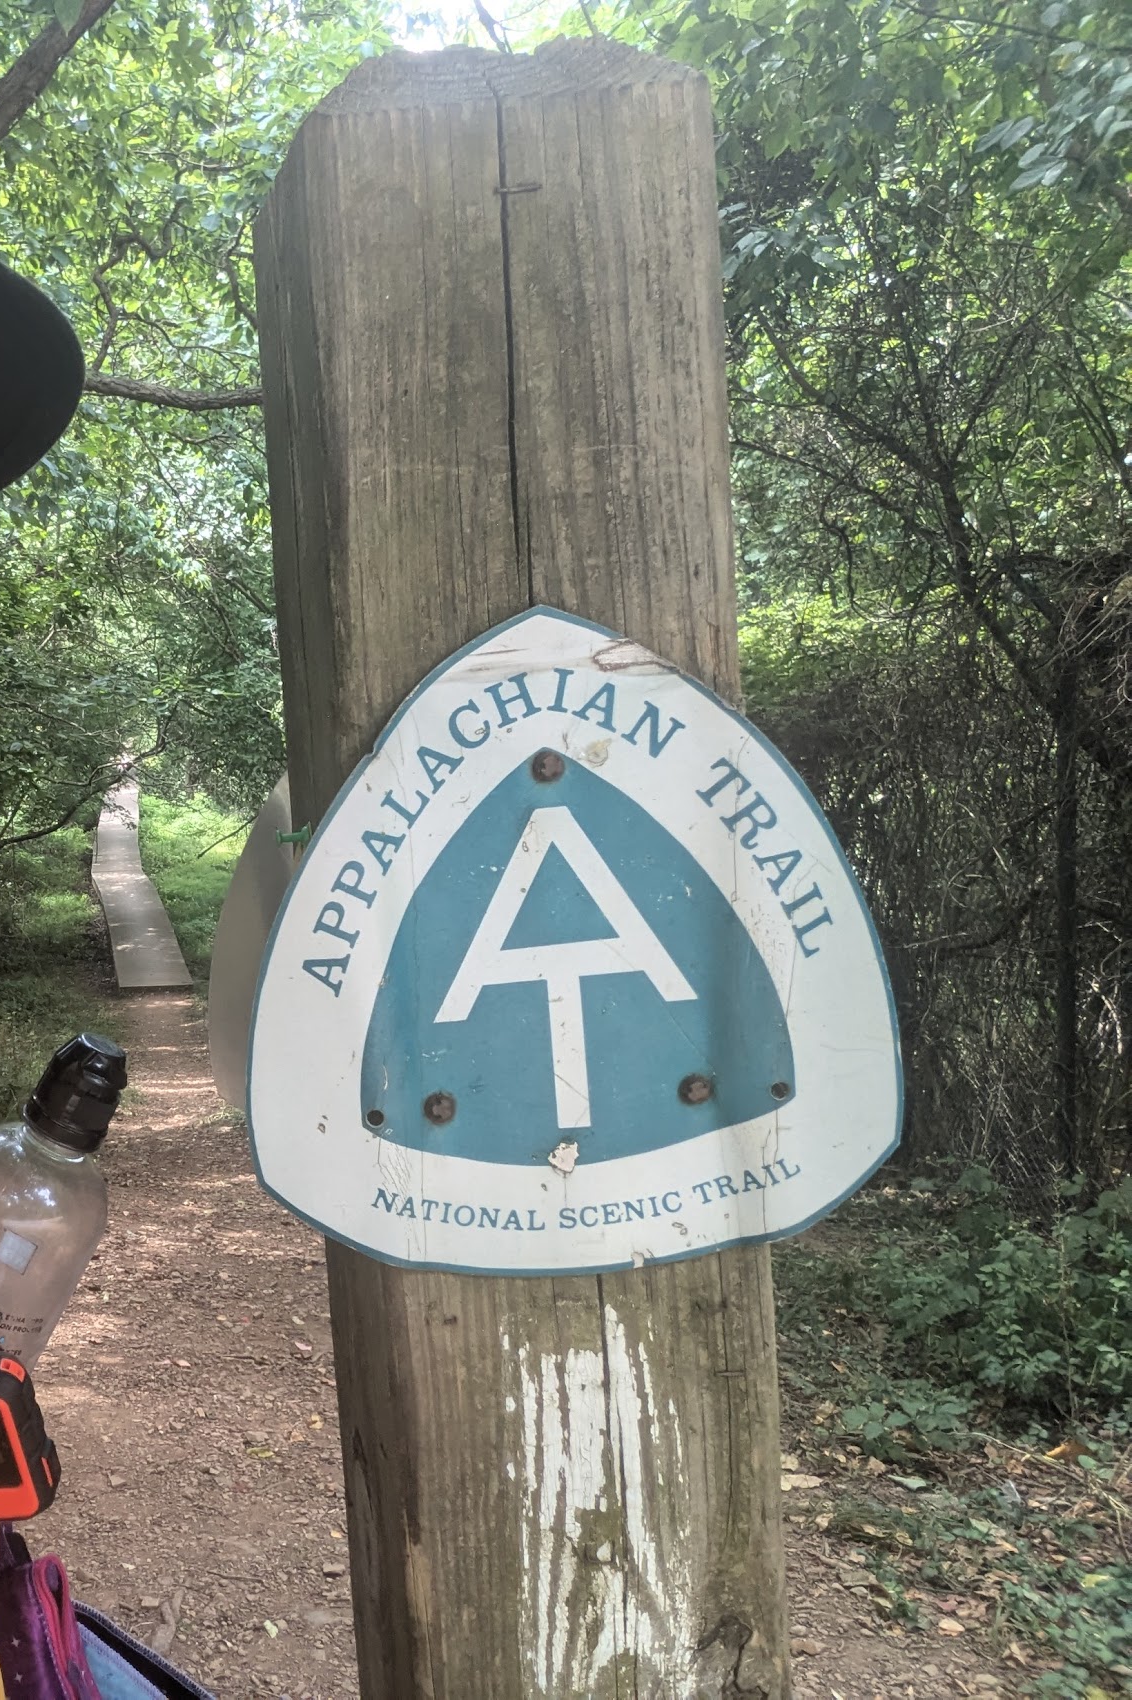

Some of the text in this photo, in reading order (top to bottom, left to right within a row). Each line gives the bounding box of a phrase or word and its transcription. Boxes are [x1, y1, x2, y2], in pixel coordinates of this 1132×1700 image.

[300, 667, 835, 998] APPALACHIAN TRAIL
[371, 1157, 801, 1232] NATIONAL SCENIC TRAIL
